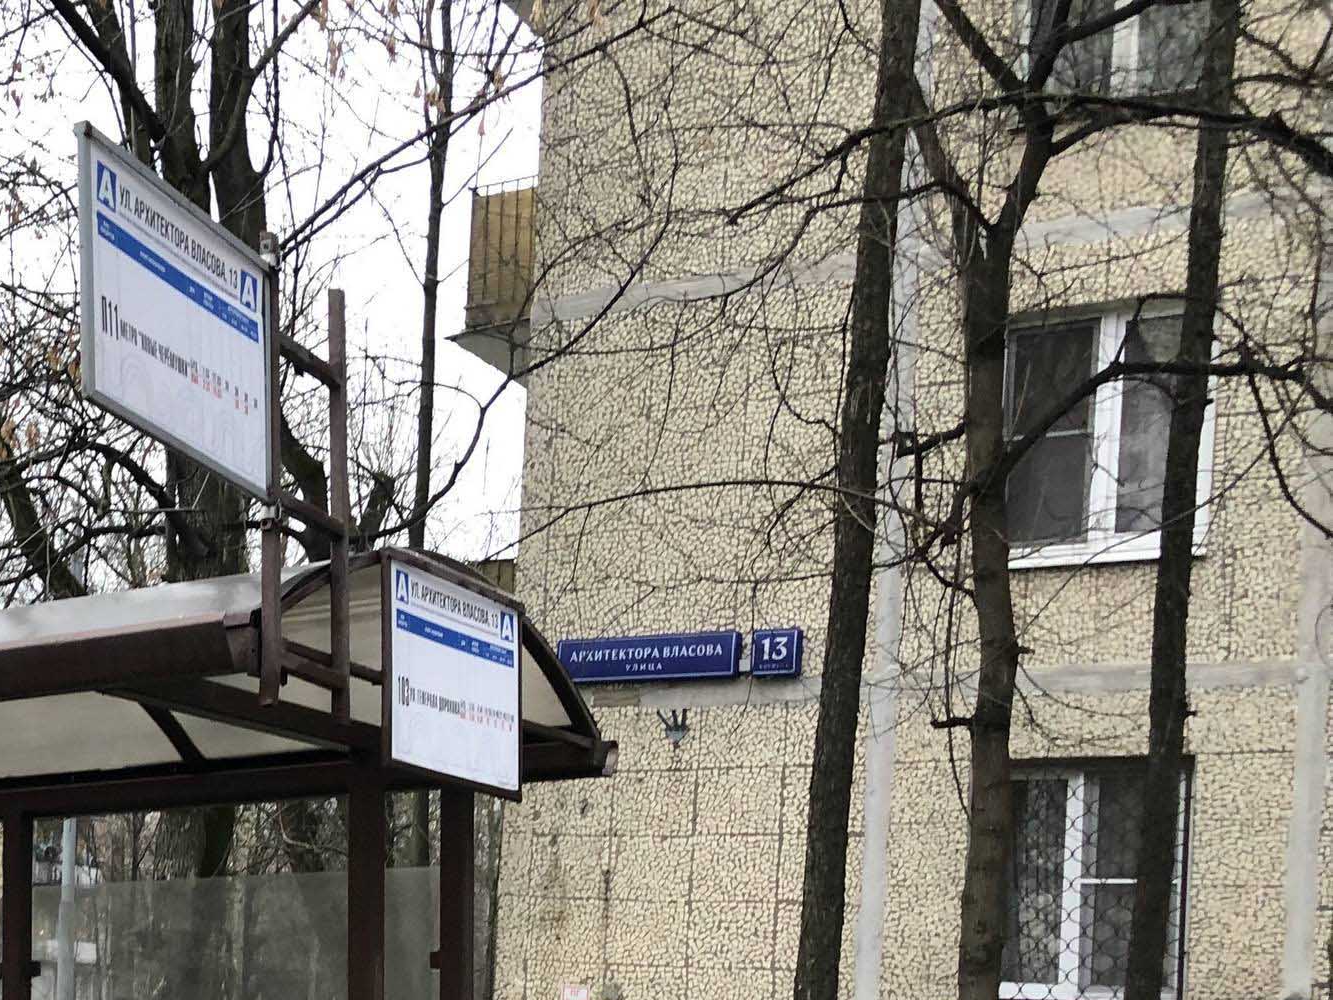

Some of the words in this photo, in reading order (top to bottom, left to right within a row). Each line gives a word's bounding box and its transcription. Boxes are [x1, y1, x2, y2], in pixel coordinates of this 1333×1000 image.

[119, 183, 133, 219] УЛ.
[133, 195, 191, 255] АРХИТЕКТОРА
[229, 266, 239, 292] 13
[101, 295, 120, 346] П11
[420, 583, 462, 617] АРХИТЕКТОРА
[491, 612, 499, 629] 13
[570, 646, 660, 664] АРХИТЕКТОРА
[663, 643, 723, 660] ВЛАСОВА
[761, 637, 788, 661] 13
[625, 662, 663, 673] УЛИЦА
[397, 675, 410, 706] 103
